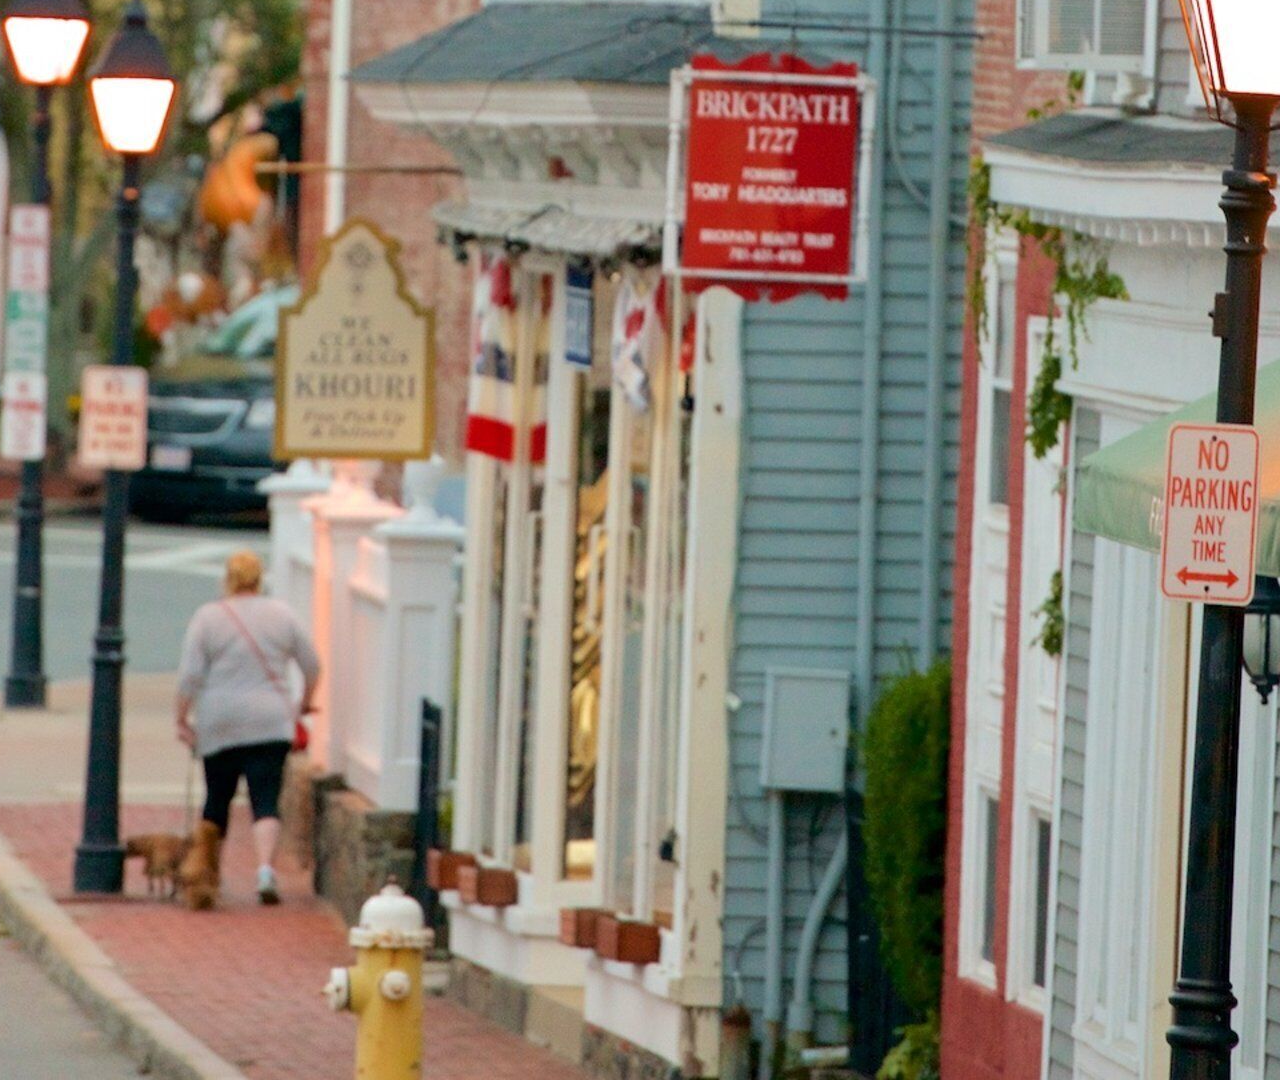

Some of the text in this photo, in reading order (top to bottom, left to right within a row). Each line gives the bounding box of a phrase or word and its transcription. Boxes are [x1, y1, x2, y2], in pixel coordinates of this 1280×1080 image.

[697, 90, 850, 124] BRICKPATH
[746, 126, 798, 155] 1727
[693, 182, 847, 207] TORY HEADQUARTERS
[320, 332, 394, 346] CLEAN
[295, 373, 416, 400] KHOURI
[1198, 440, 1229, 472] NO
[1171, 476, 1252, 512] PARKING
[1194, 514, 1226, 536] ANY
[1191, 540, 1226, 563] TIME
